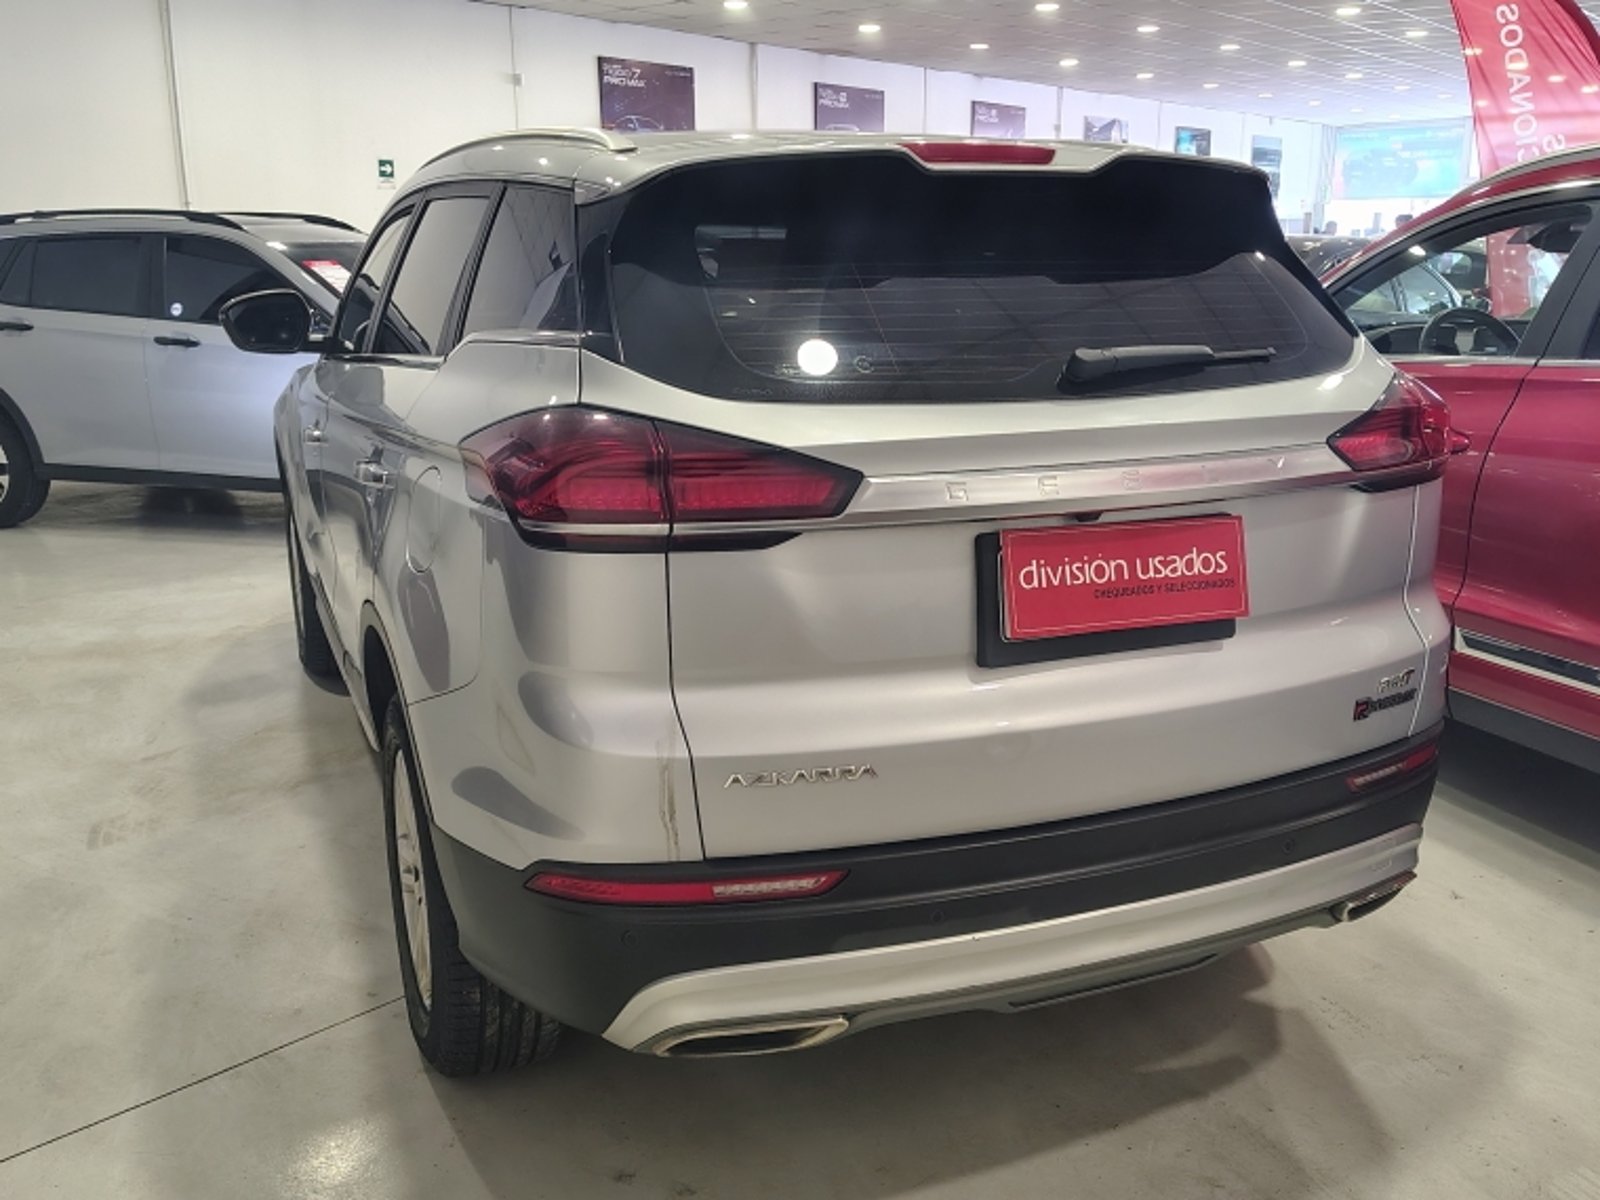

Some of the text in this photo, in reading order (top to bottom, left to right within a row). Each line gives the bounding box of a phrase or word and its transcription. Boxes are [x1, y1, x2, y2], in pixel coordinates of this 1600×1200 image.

[1019, 546, 1229, 590] división usados
[1164, 578, 1236, 594] SELECCIONADOS
[723, 764, 879, 789] AZKARRA
